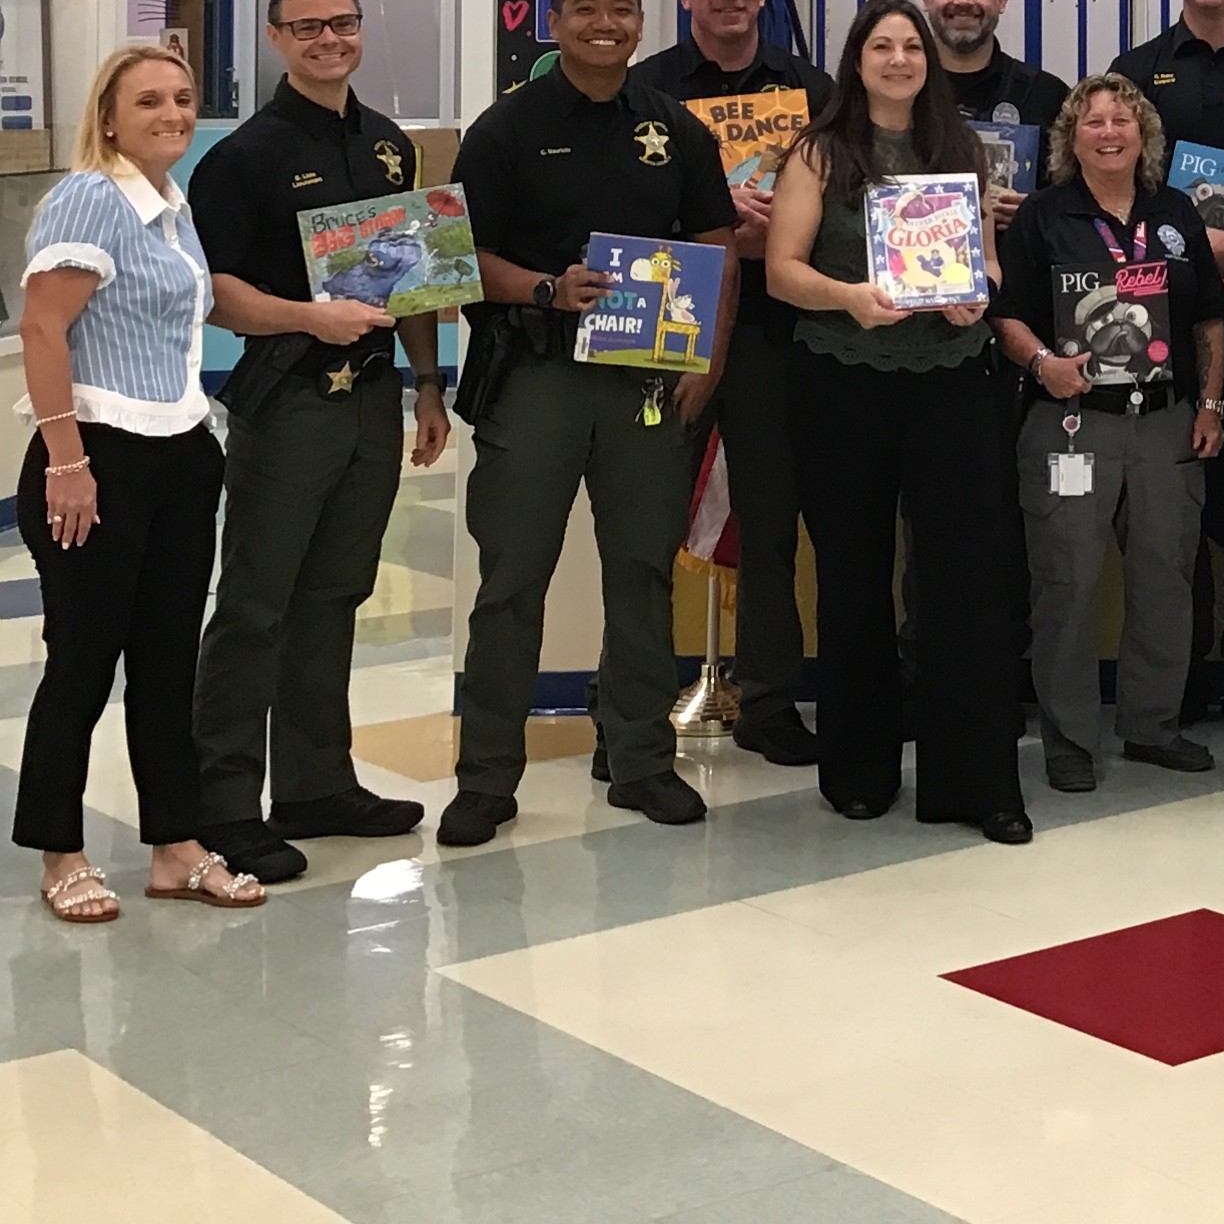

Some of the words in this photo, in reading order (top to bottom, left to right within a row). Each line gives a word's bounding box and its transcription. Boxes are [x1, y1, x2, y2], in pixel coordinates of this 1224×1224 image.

[709, 101, 754, 124] BEE
[726, 113, 804, 143] DANCE
[1180, 152, 1217, 177] PIG
[887, 218, 968, 248] GLORIA
[609, 247, 623, 267] I
[1060, 271, 1100, 294] PIG
[637, 297, 646, 308] A
[584, 313, 643, 334] CHAIR!
